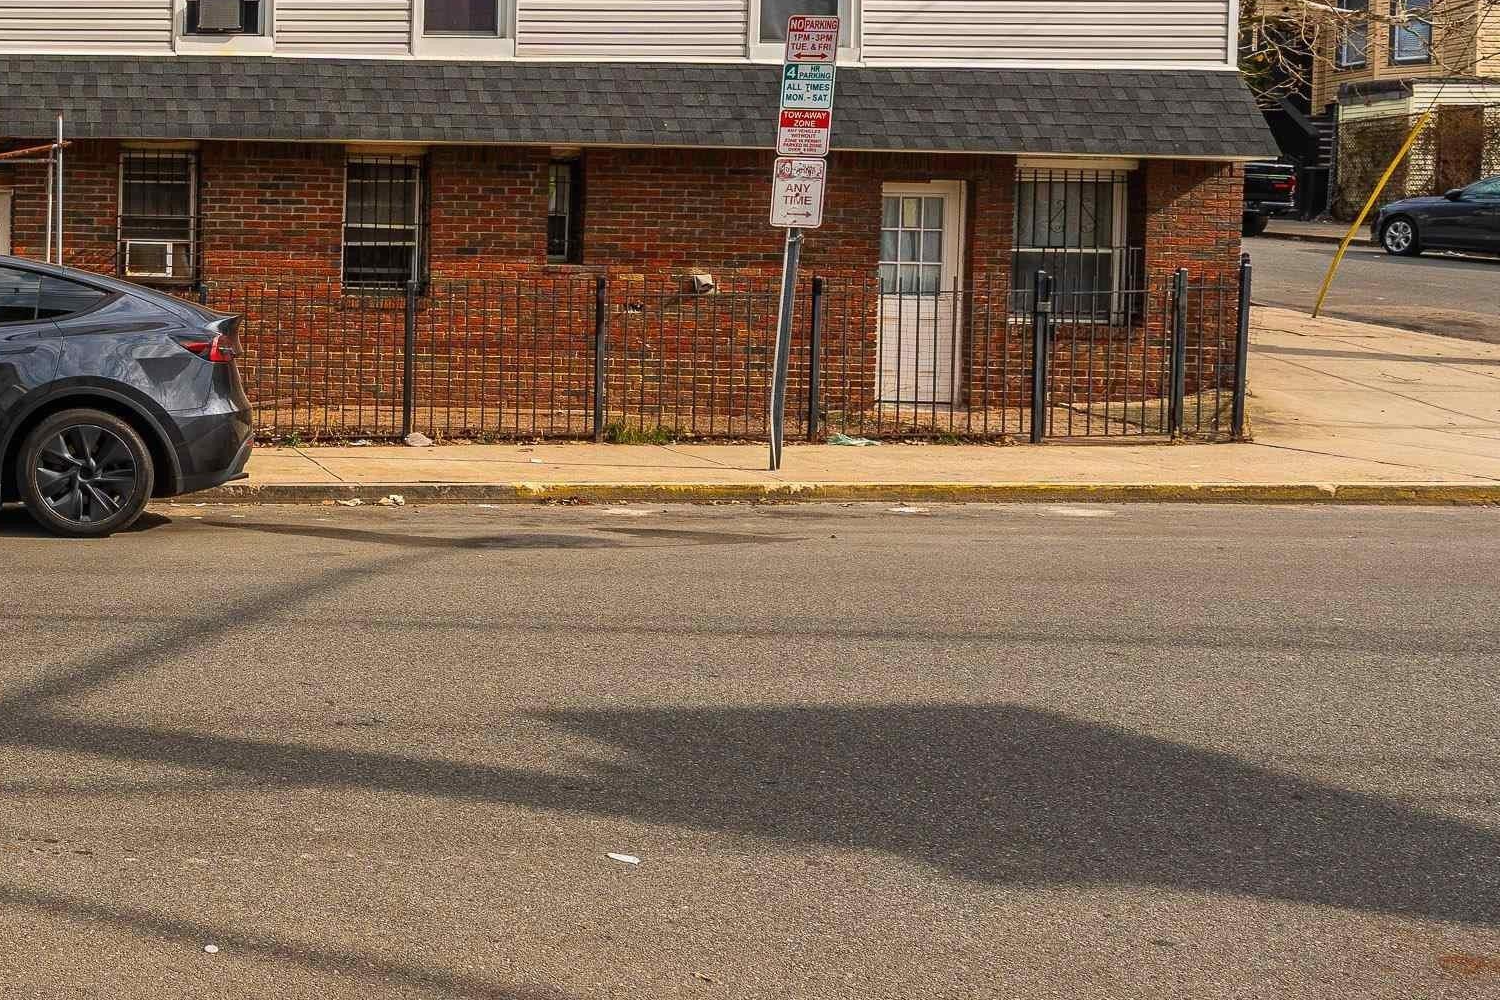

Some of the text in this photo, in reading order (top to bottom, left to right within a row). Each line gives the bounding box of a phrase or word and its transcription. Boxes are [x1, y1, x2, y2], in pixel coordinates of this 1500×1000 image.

[790, 19, 838, 30] NO PARKING
[794, 33, 810, 41] 1PM
[815, 34, 833, 42] 3PM
[810, 43, 817, 51] &
[786, 66, 831, 80] 4 PARKING
[810, 65, 821, 73] HR
[786, 82, 830, 91] ALL TIMES
[785, 93, 806, 102] MON.
[812, 94, 829, 102] SAT.
[783, 111, 828, 120] TOW-AWAY
[793, 119, 816, 127] ZONE
[785, 183, 811, 193] ANY
[782, 195, 813, 206] TIME
